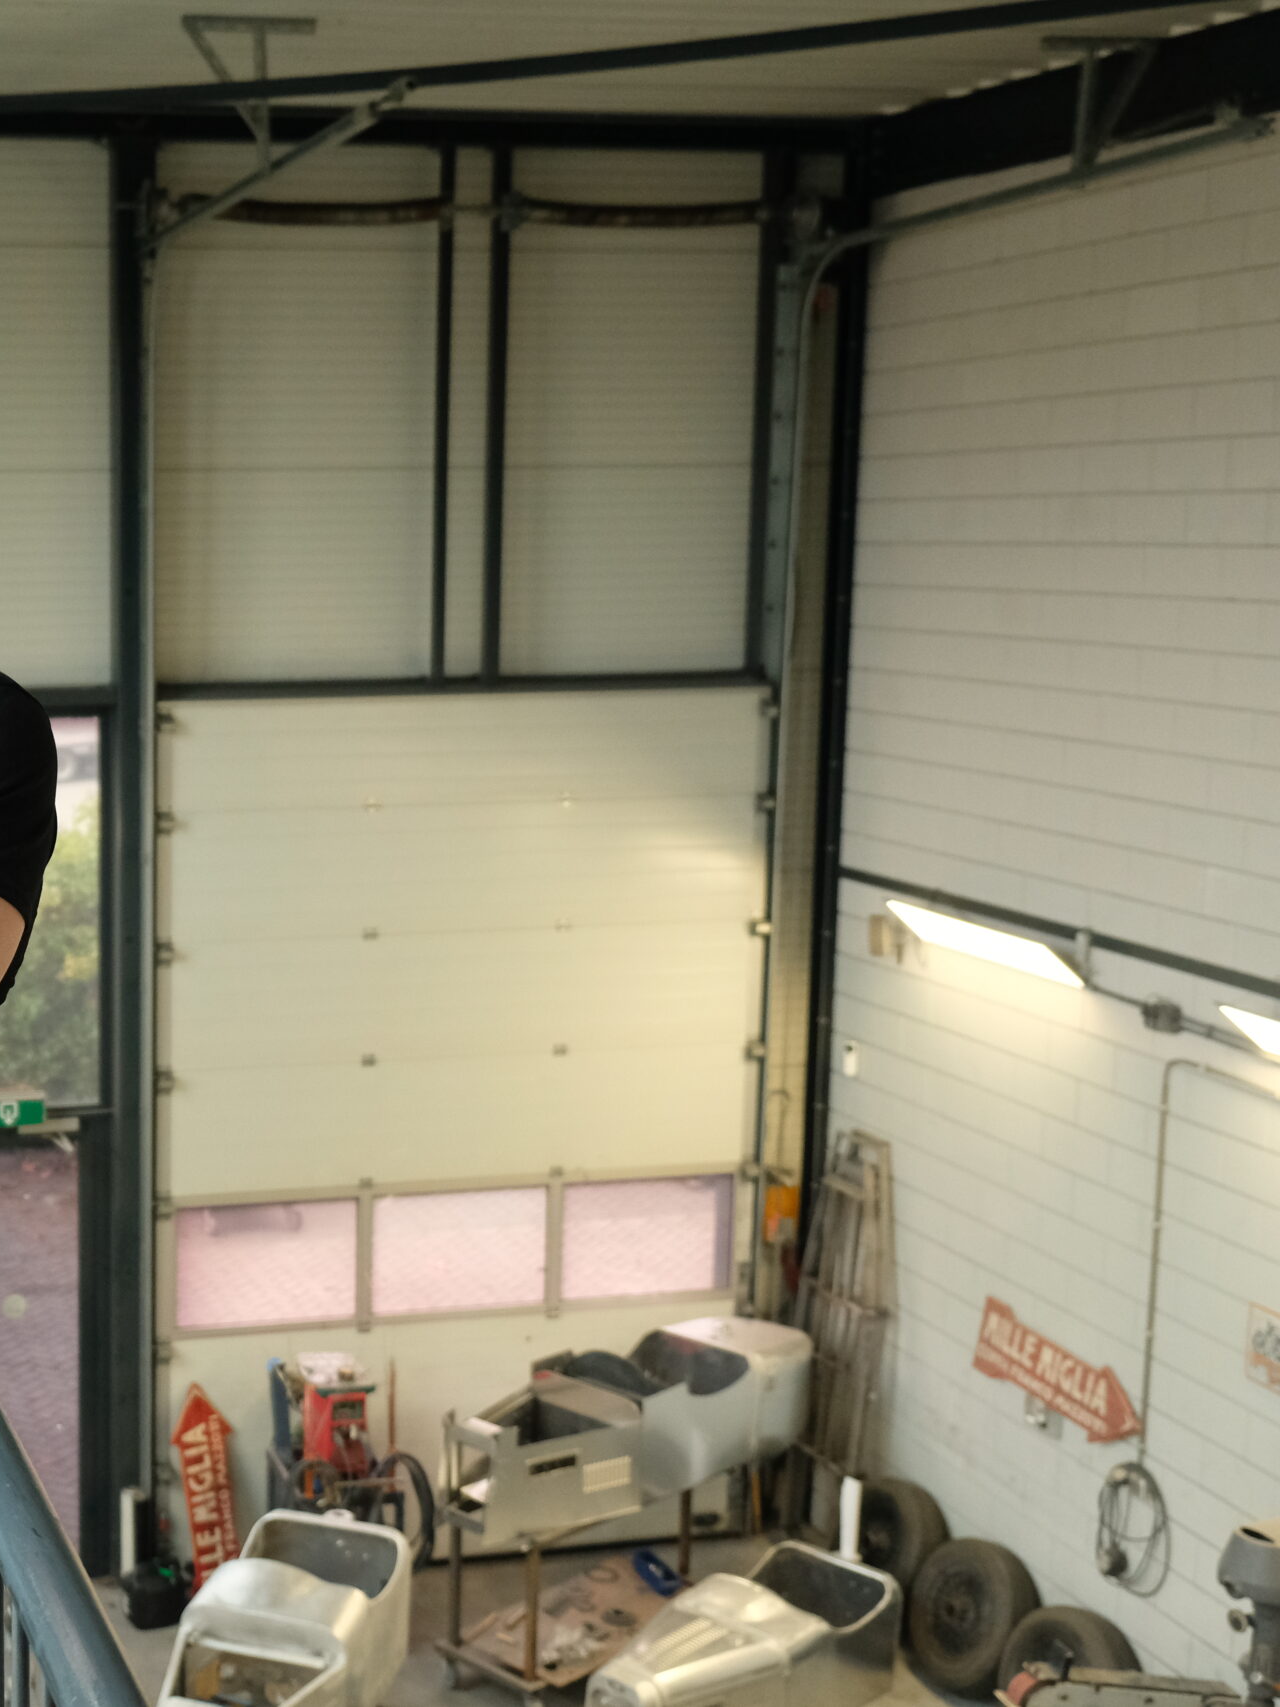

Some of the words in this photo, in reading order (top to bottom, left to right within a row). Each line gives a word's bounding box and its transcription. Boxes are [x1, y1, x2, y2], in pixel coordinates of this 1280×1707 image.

[1035, 1345, 1108, 1418] MIGLIA
[180, 1421, 219, 1525] MIGLIA
[195, 1525, 224, 1586] LLE
